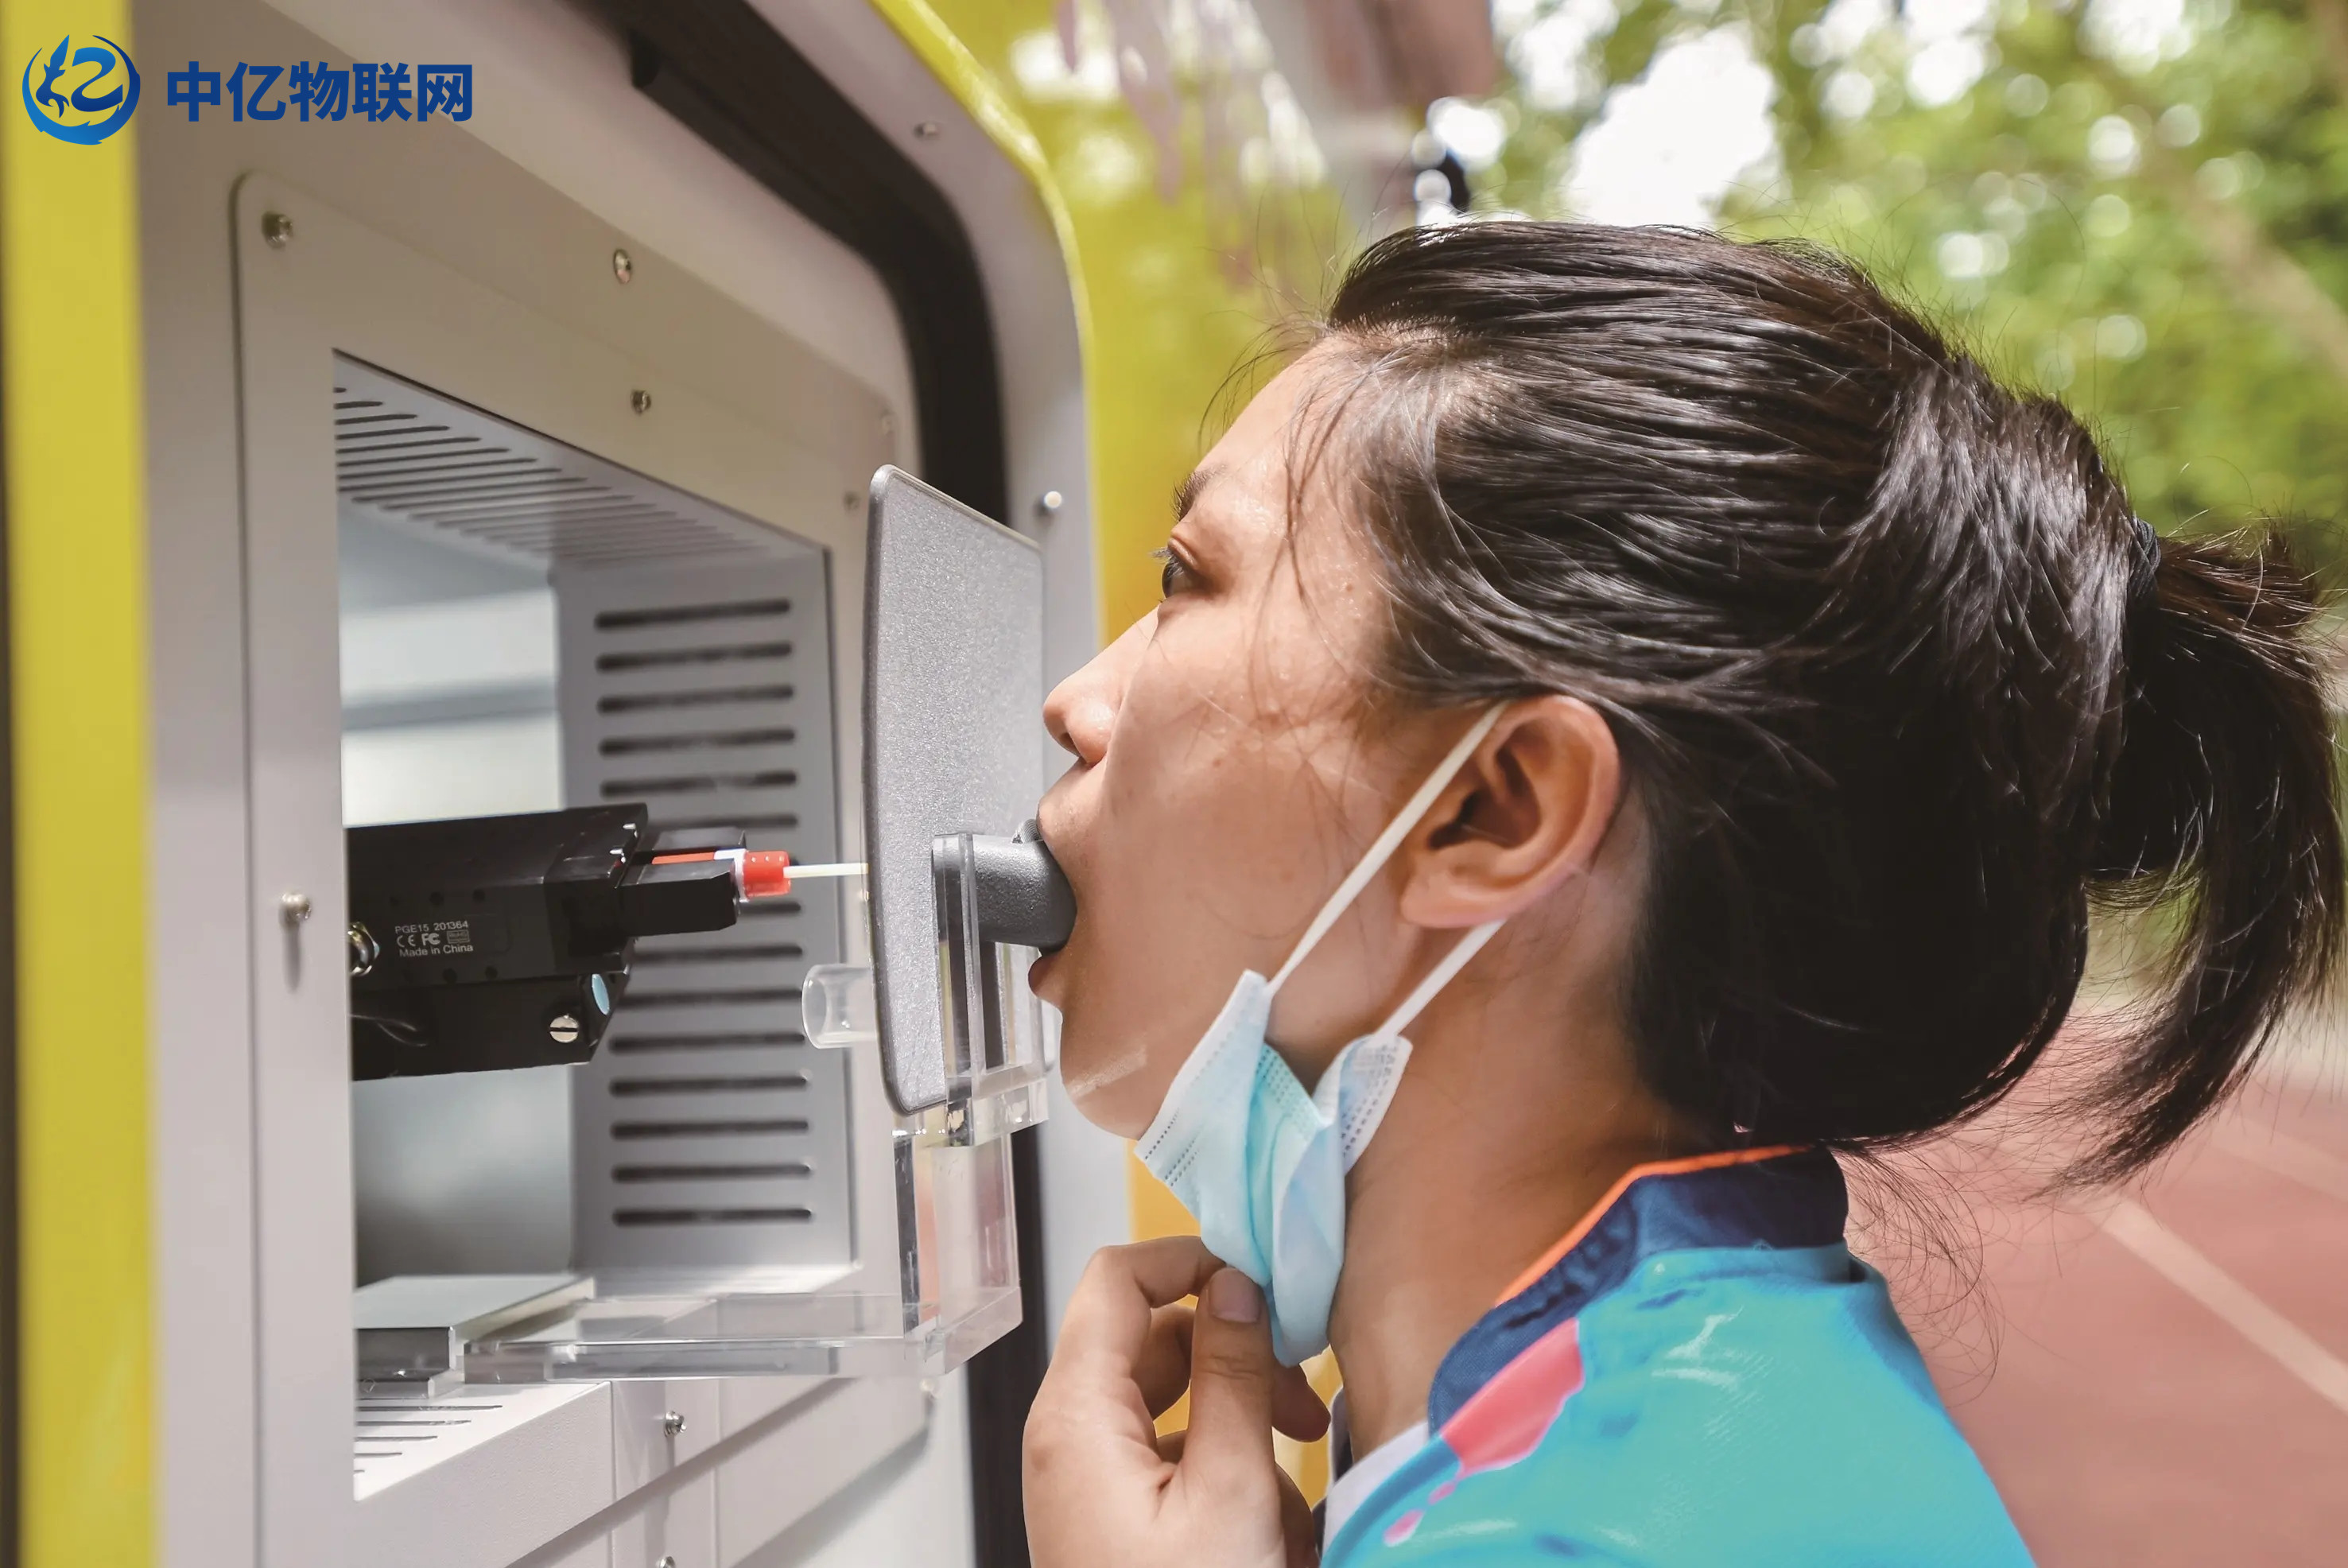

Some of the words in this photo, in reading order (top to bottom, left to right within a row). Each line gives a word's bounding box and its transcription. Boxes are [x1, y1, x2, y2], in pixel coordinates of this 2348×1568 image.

[395, 924, 429, 934] PGE15
[399, 947, 428, 957] Made
[443, 944, 474, 953] China
